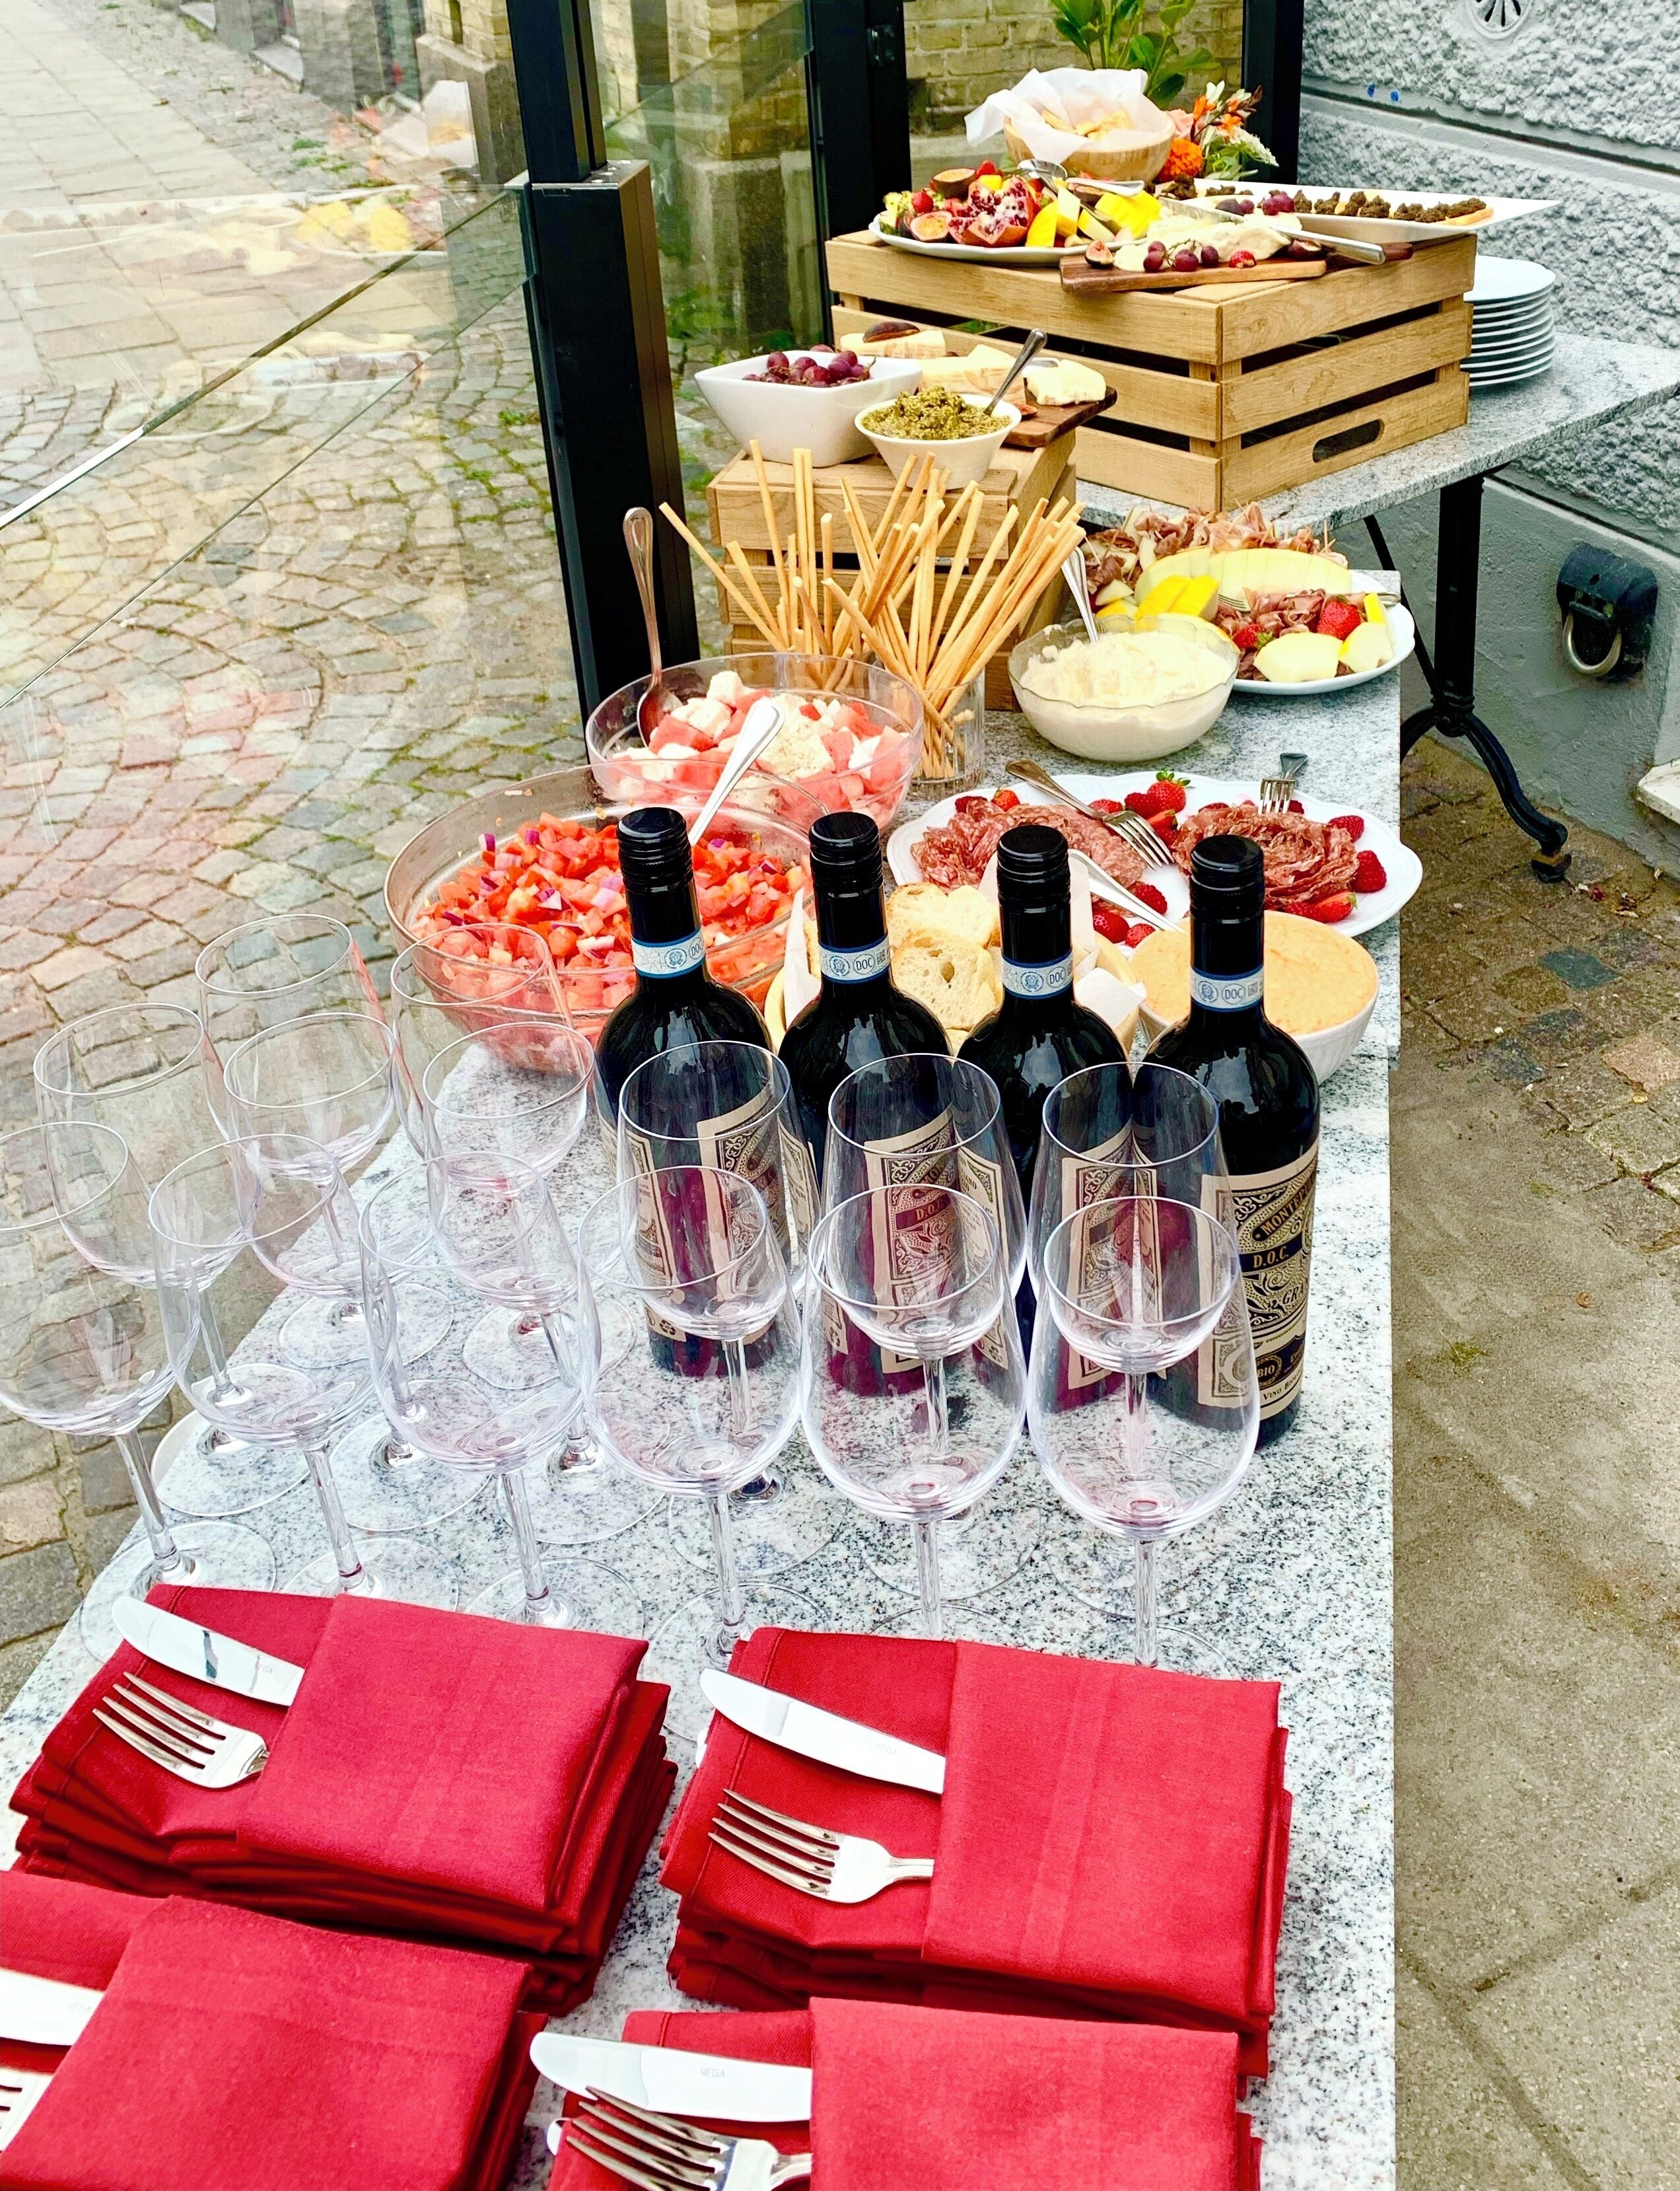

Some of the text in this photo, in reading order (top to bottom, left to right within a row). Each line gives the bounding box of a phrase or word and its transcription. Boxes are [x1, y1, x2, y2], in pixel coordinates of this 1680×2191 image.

[856, 957, 872, 971] DOC
[1049, 969, 1064, 985] DOC
[1224, 988, 1242, 999] DOC
[1253, 1245, 1289, 1268] D.O.C.
[1257, 1365, 1275, 1379] BIO
[1263, 1386, 1282, 1401] VINO
[700, 2067, 726, 2079] VEGA
